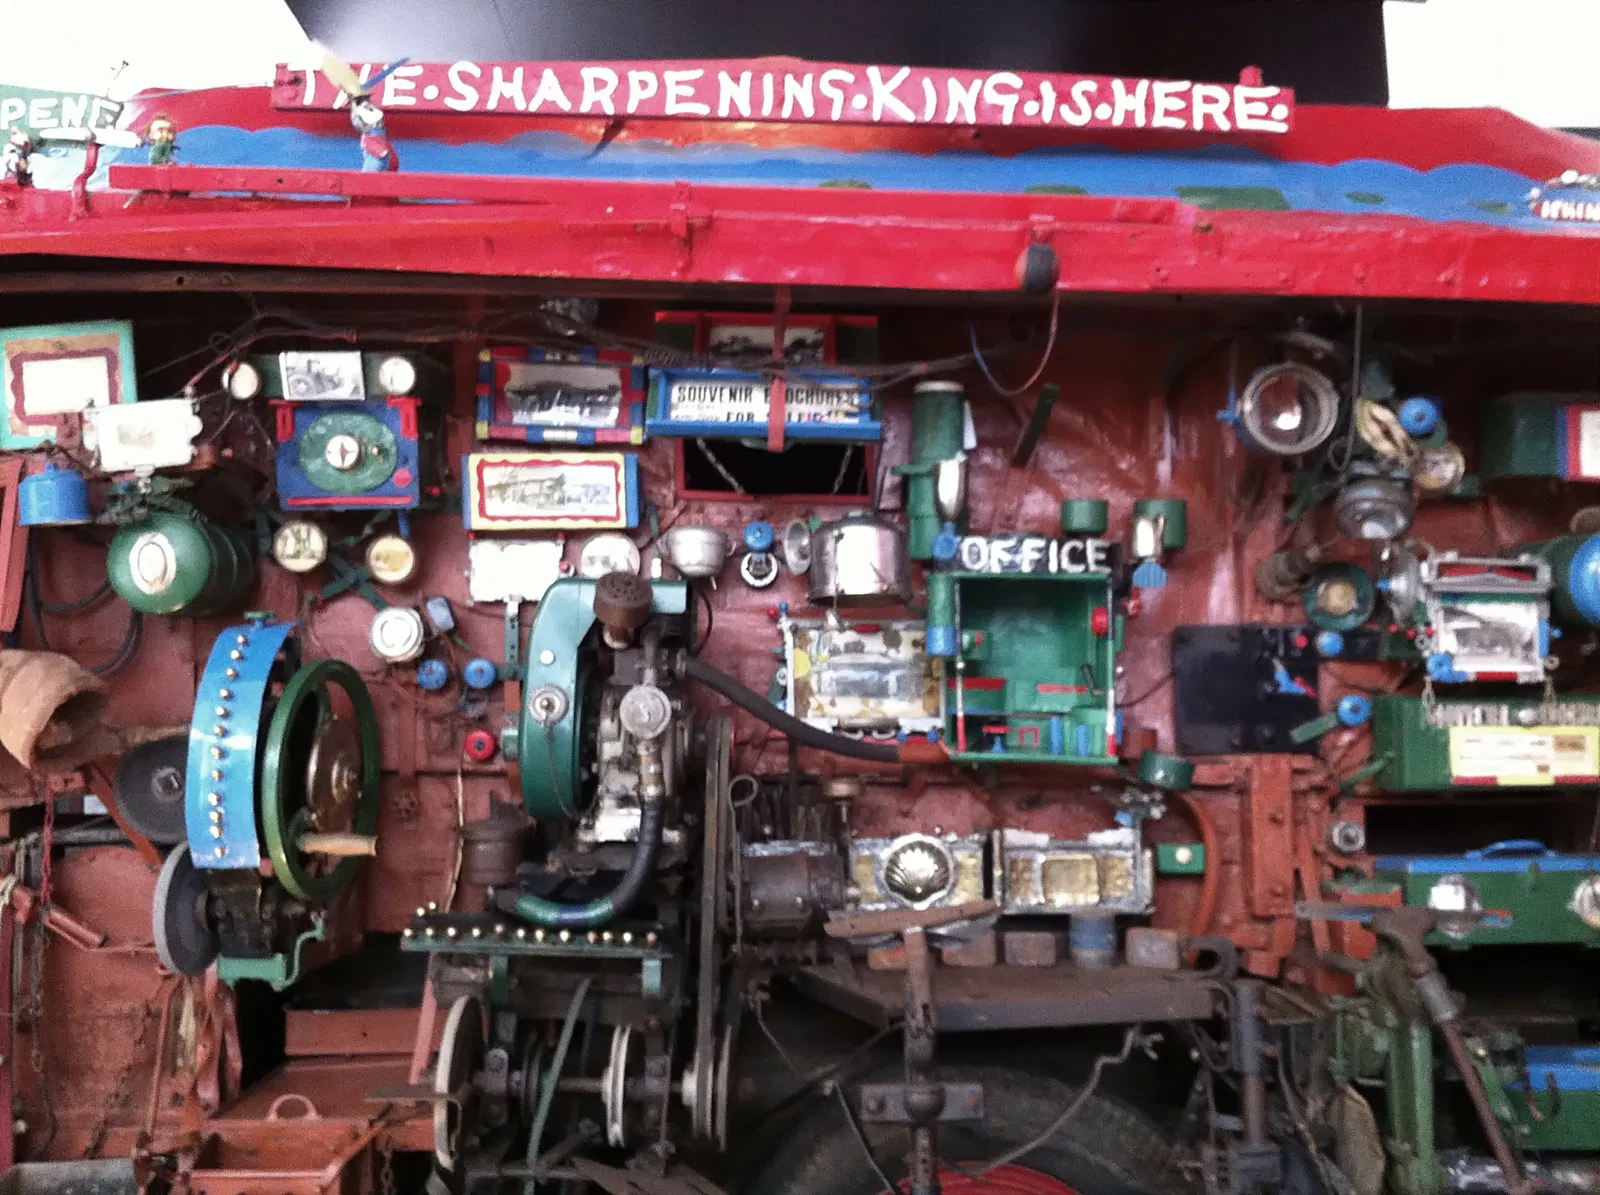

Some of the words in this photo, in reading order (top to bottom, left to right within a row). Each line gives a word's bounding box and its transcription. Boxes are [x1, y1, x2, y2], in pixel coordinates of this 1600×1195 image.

[677, 385, 753, 404] SOUVENIR
[764, 386, 859, 406] OCHURE
[961, 536, 1112, 574] OFFICE
